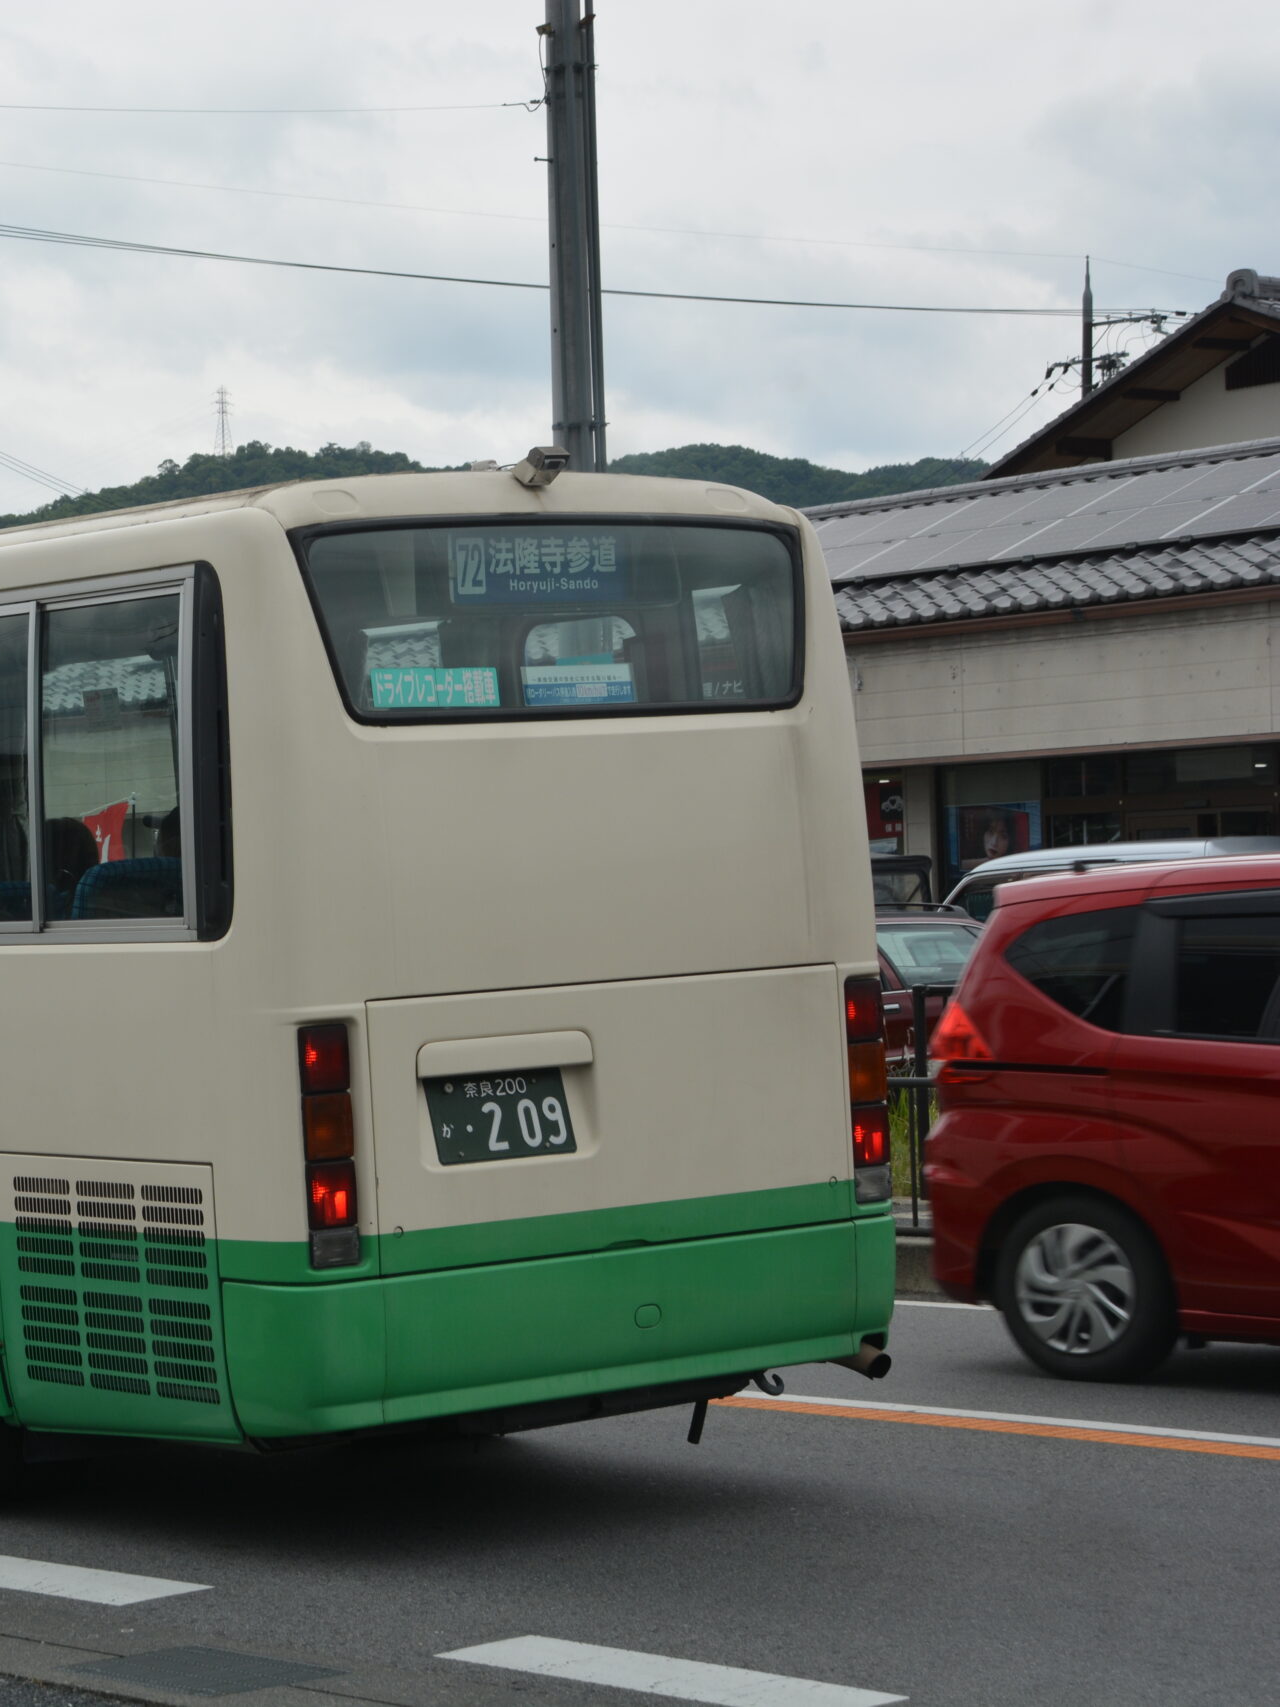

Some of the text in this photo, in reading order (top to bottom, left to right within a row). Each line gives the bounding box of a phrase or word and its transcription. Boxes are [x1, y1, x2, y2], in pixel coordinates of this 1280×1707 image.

[458, 543, 483, 588] 72
[488, 536, 617, 575] 法隆寺参道
[510, 577, 599, 593] Horyuji-Sando
[375, 668, 496, 704] ドライブレコーダー搭載車
[463, 1077, 527, 1099] 奈良200
[441, 1123, 455, 1139] か
